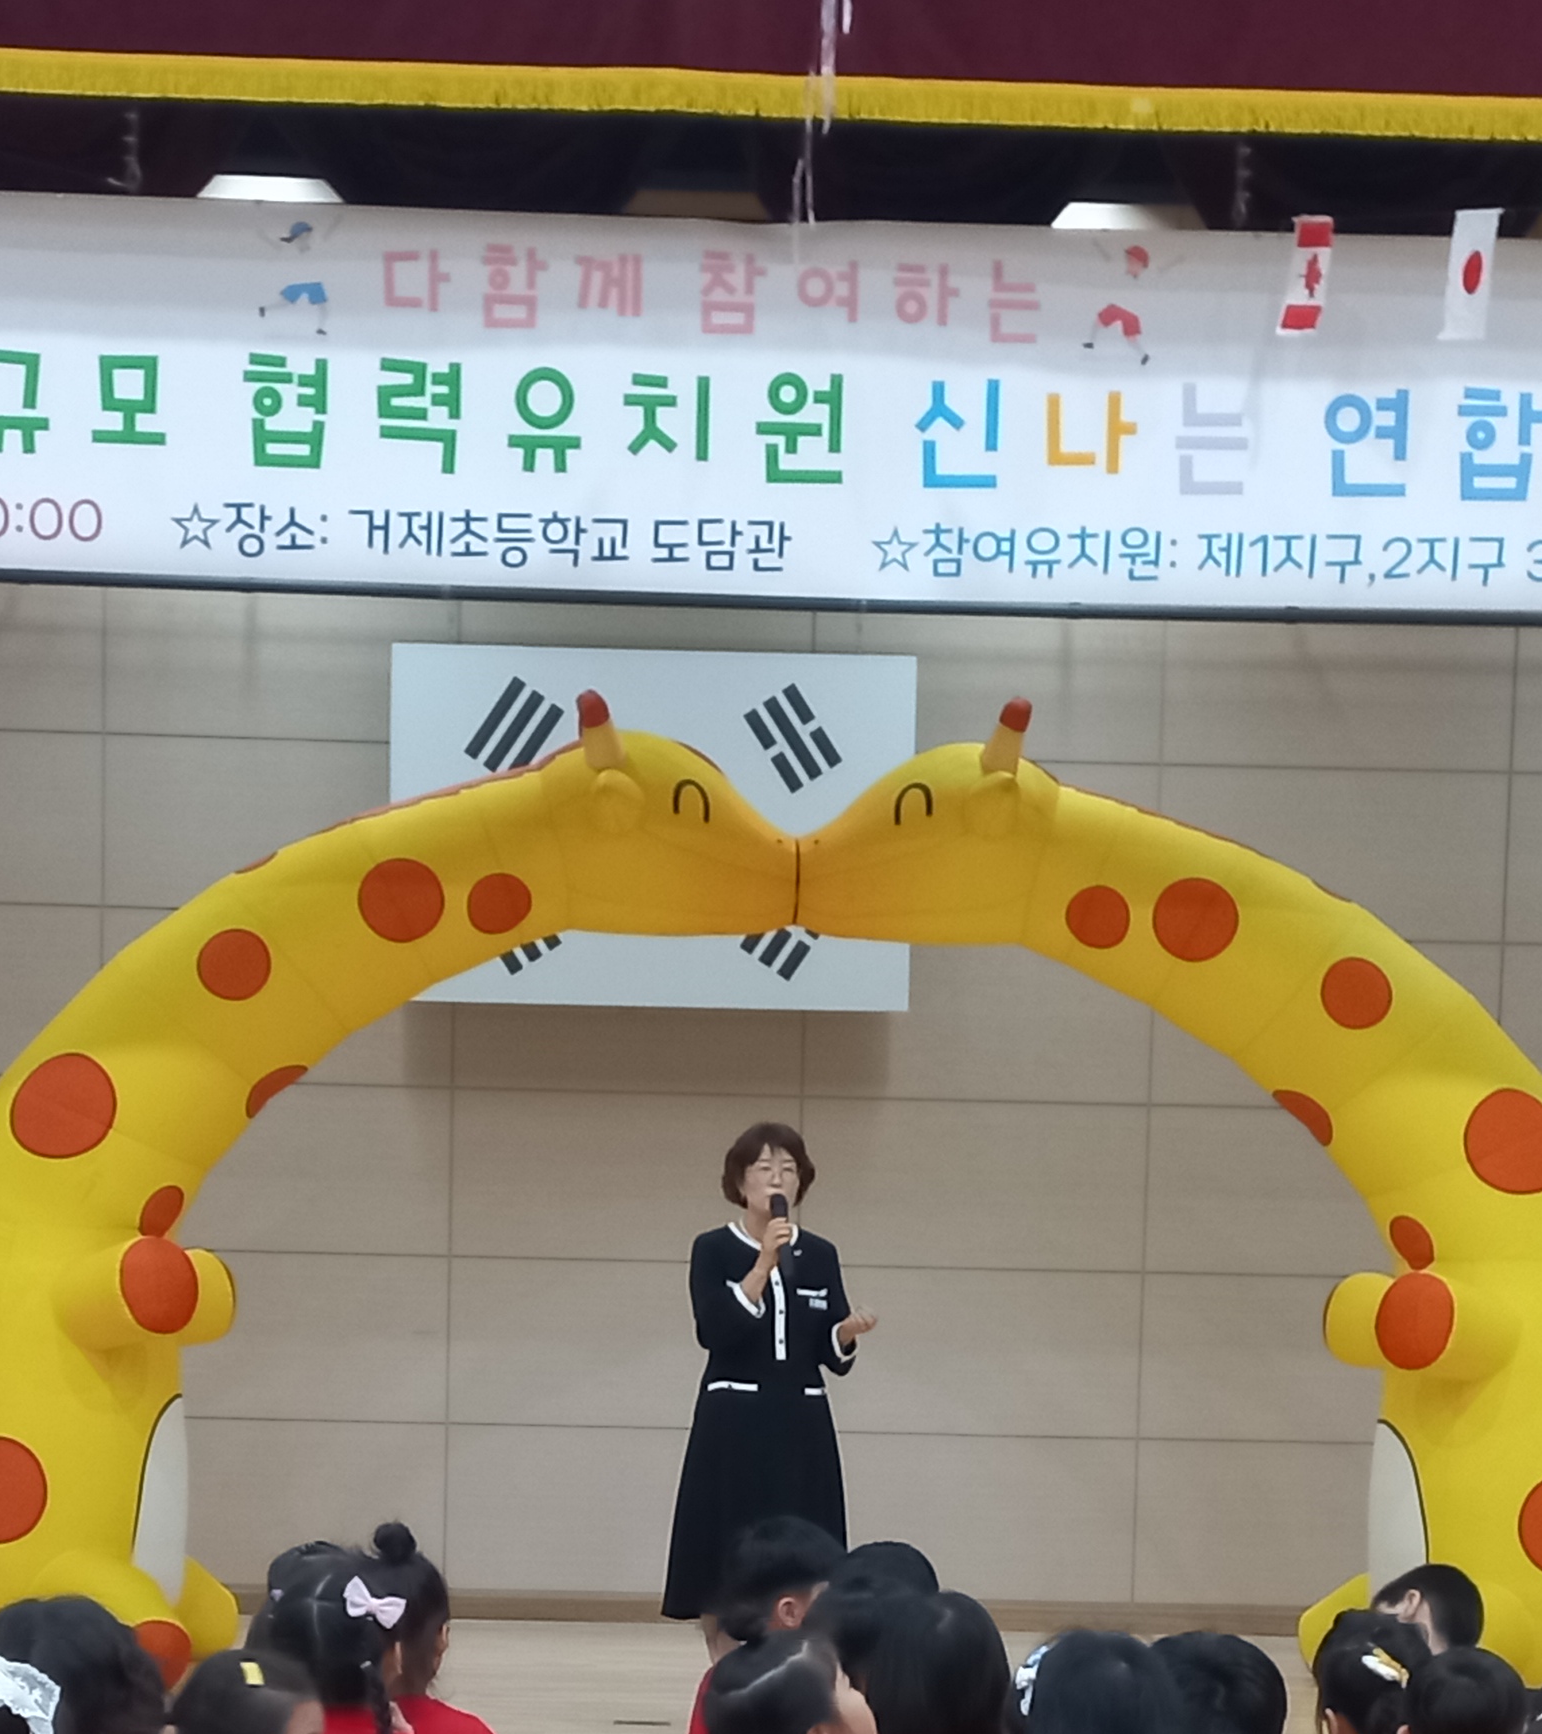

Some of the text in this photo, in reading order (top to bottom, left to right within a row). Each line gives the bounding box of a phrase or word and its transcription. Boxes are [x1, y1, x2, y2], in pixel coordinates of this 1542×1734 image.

[382, 242, 1041, 345] 다함께 참여하는
[244, 353, 845, 485] 협력유치원
[915, 378, 1249, 496] 신나는
[224, 503, 793, 573] 장소: 거제초등학교 도담관
[922, 523, 1178, 582] 참여유치원:
[1199, 533, 1506, 588] 제1지구,2지구
